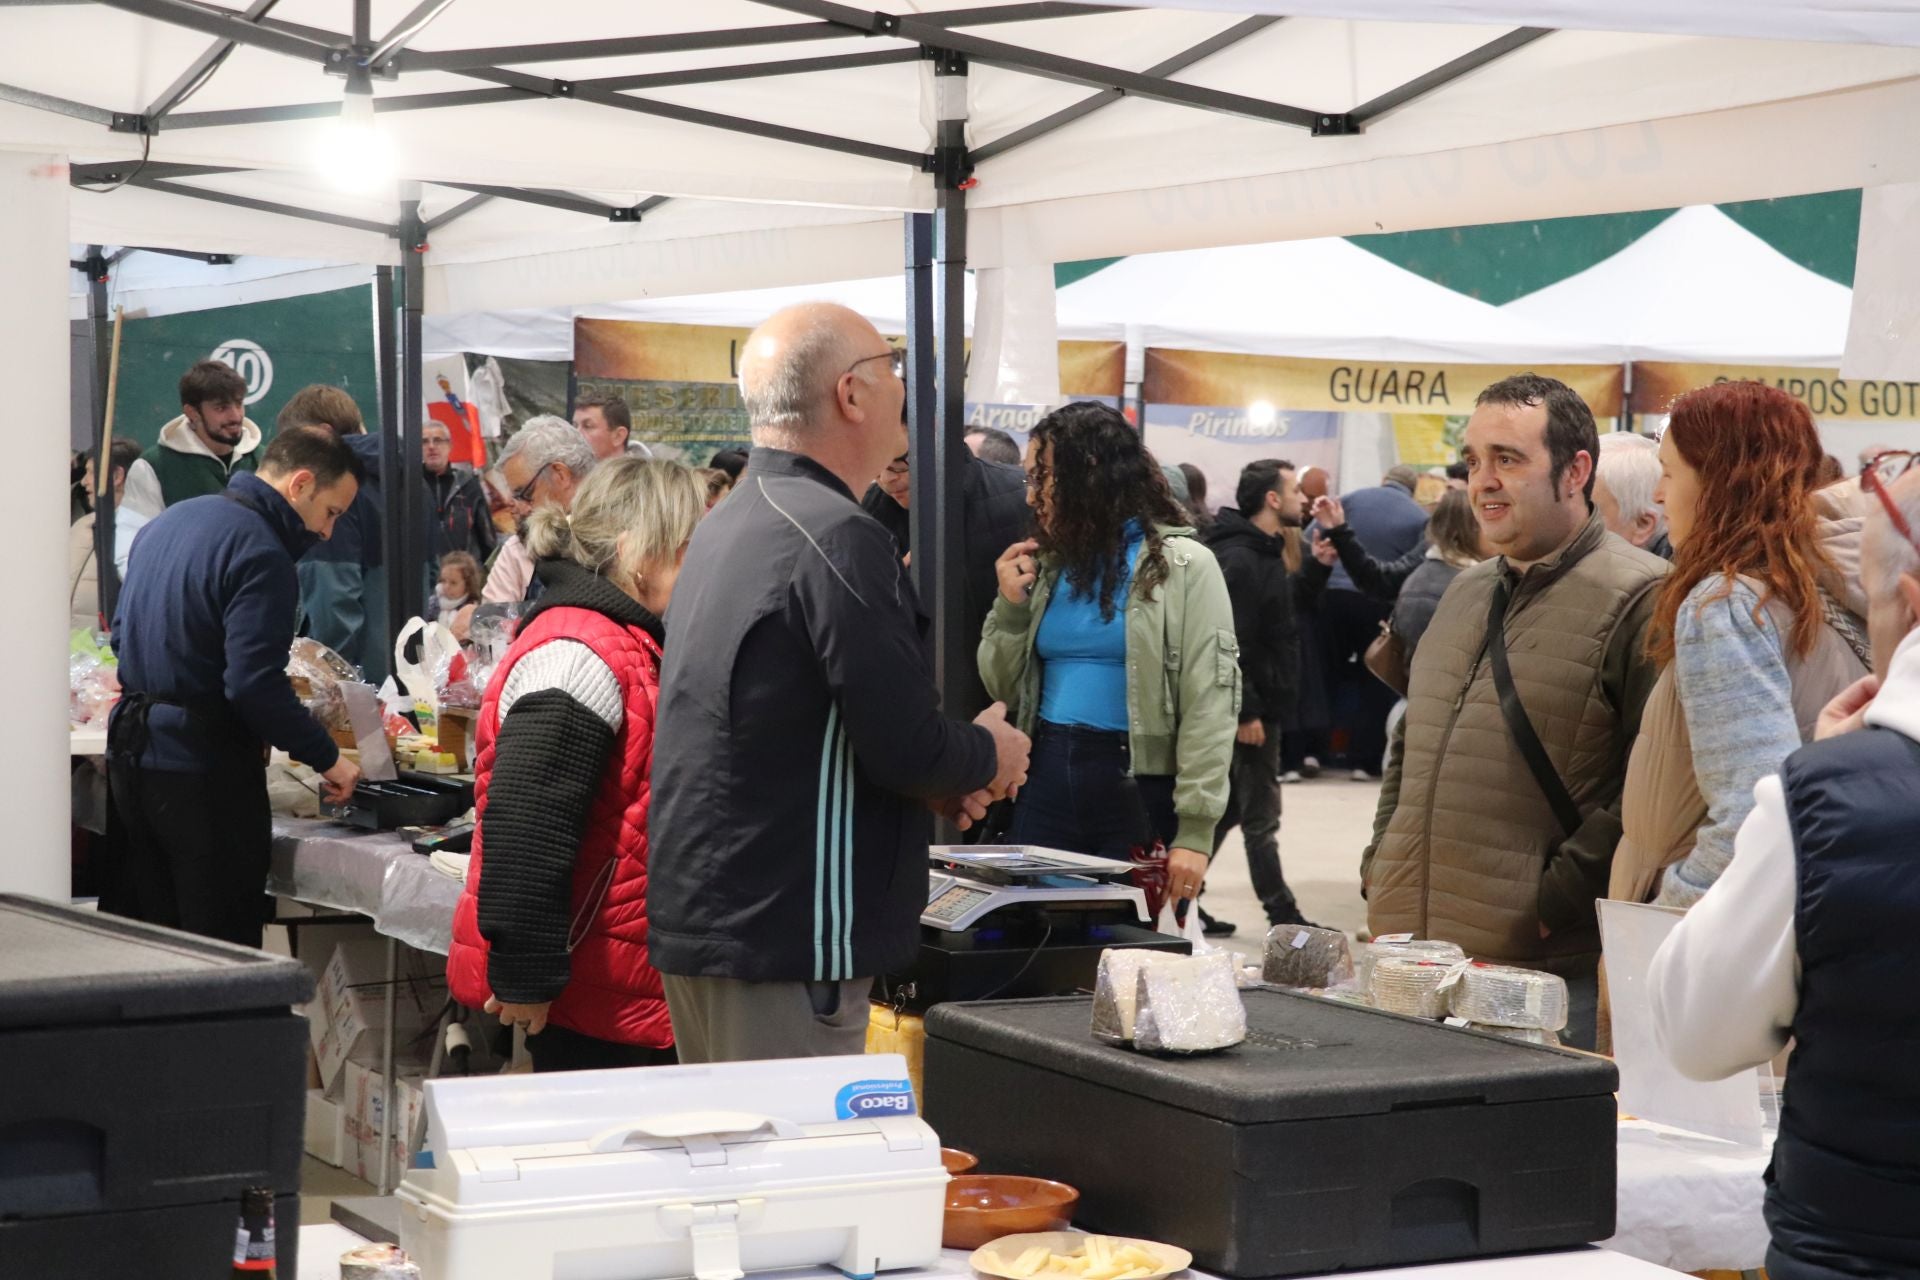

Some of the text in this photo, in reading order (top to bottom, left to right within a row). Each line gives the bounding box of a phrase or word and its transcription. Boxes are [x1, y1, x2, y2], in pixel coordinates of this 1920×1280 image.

[1330, 366, 1450, 405] GUARA
[1714, 375, 1848, 416] POS
[860, 1095, 909, 1111] Baco
